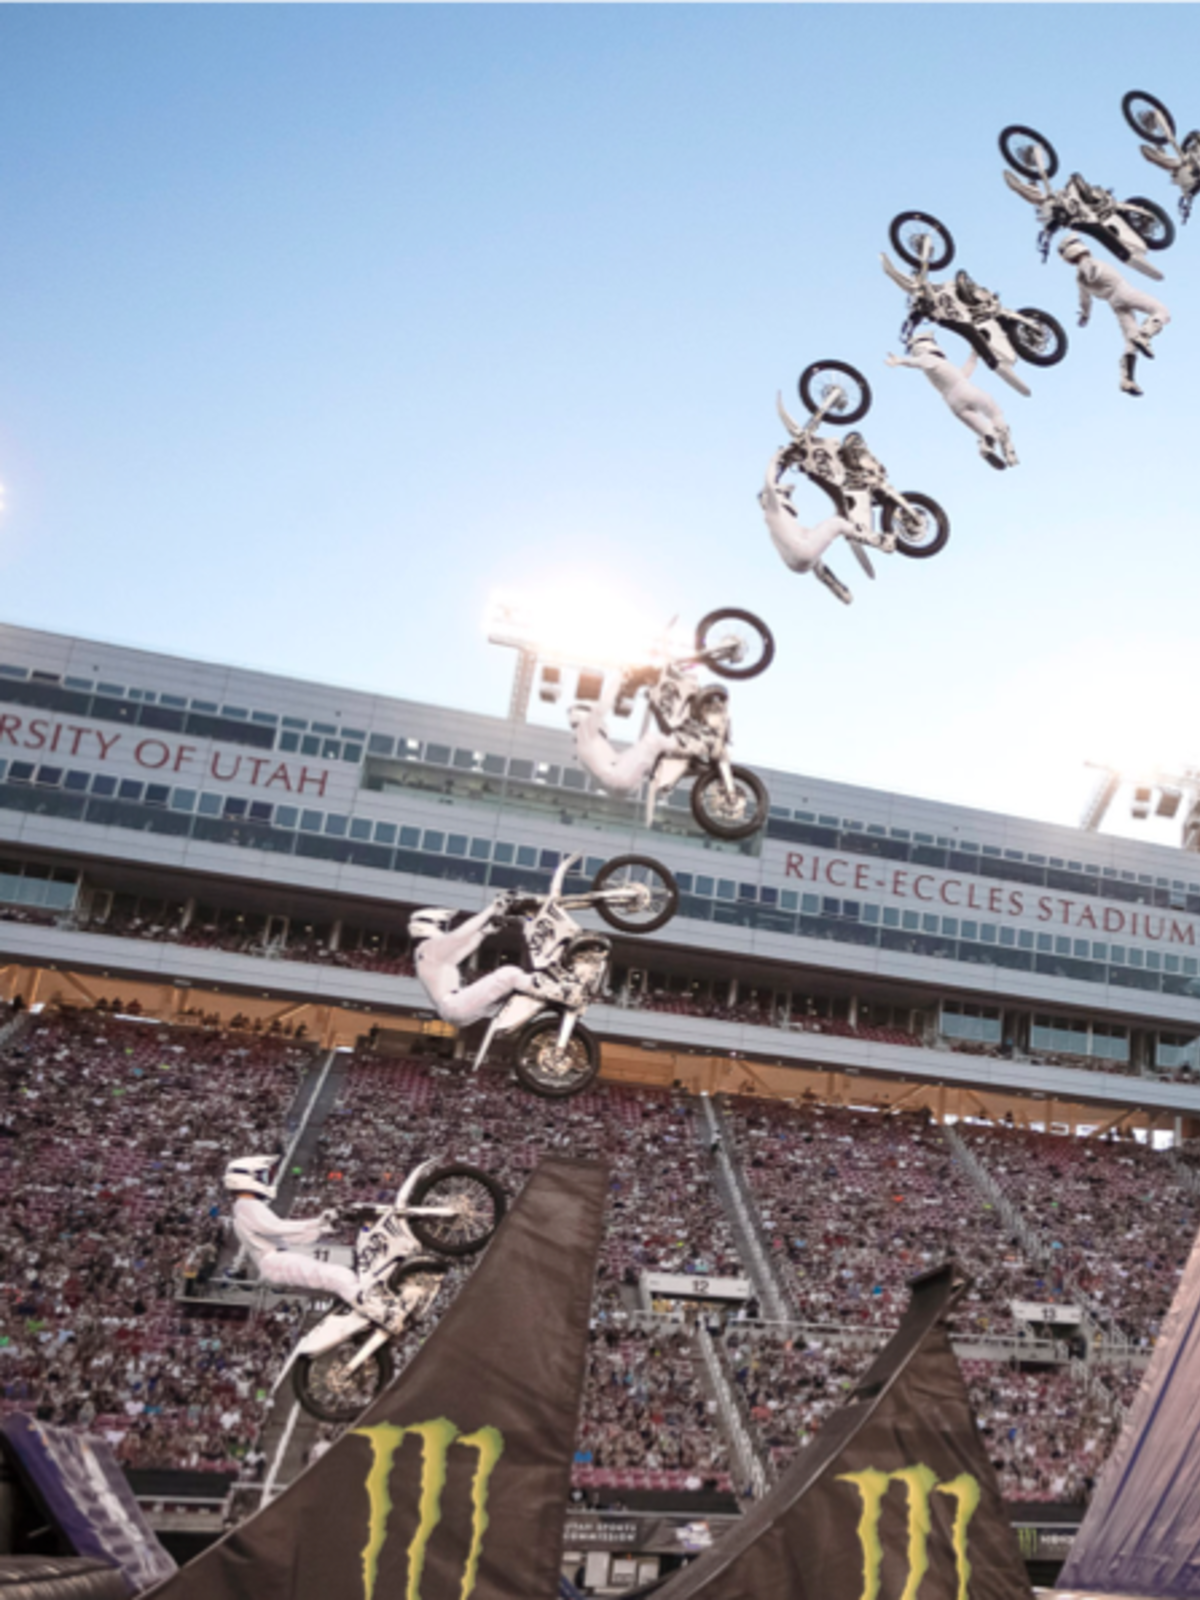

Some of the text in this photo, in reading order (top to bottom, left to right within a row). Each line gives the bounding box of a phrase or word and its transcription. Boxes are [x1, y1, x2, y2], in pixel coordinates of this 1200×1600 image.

[0, 714, 329, 797] RSITY OF UTAH
[784, 851, 1196, 946] RICE-ECCLES STADIUM
[692, 1280, 709, 1293] 12
[1042, 1307, 1056, 1320] 13
